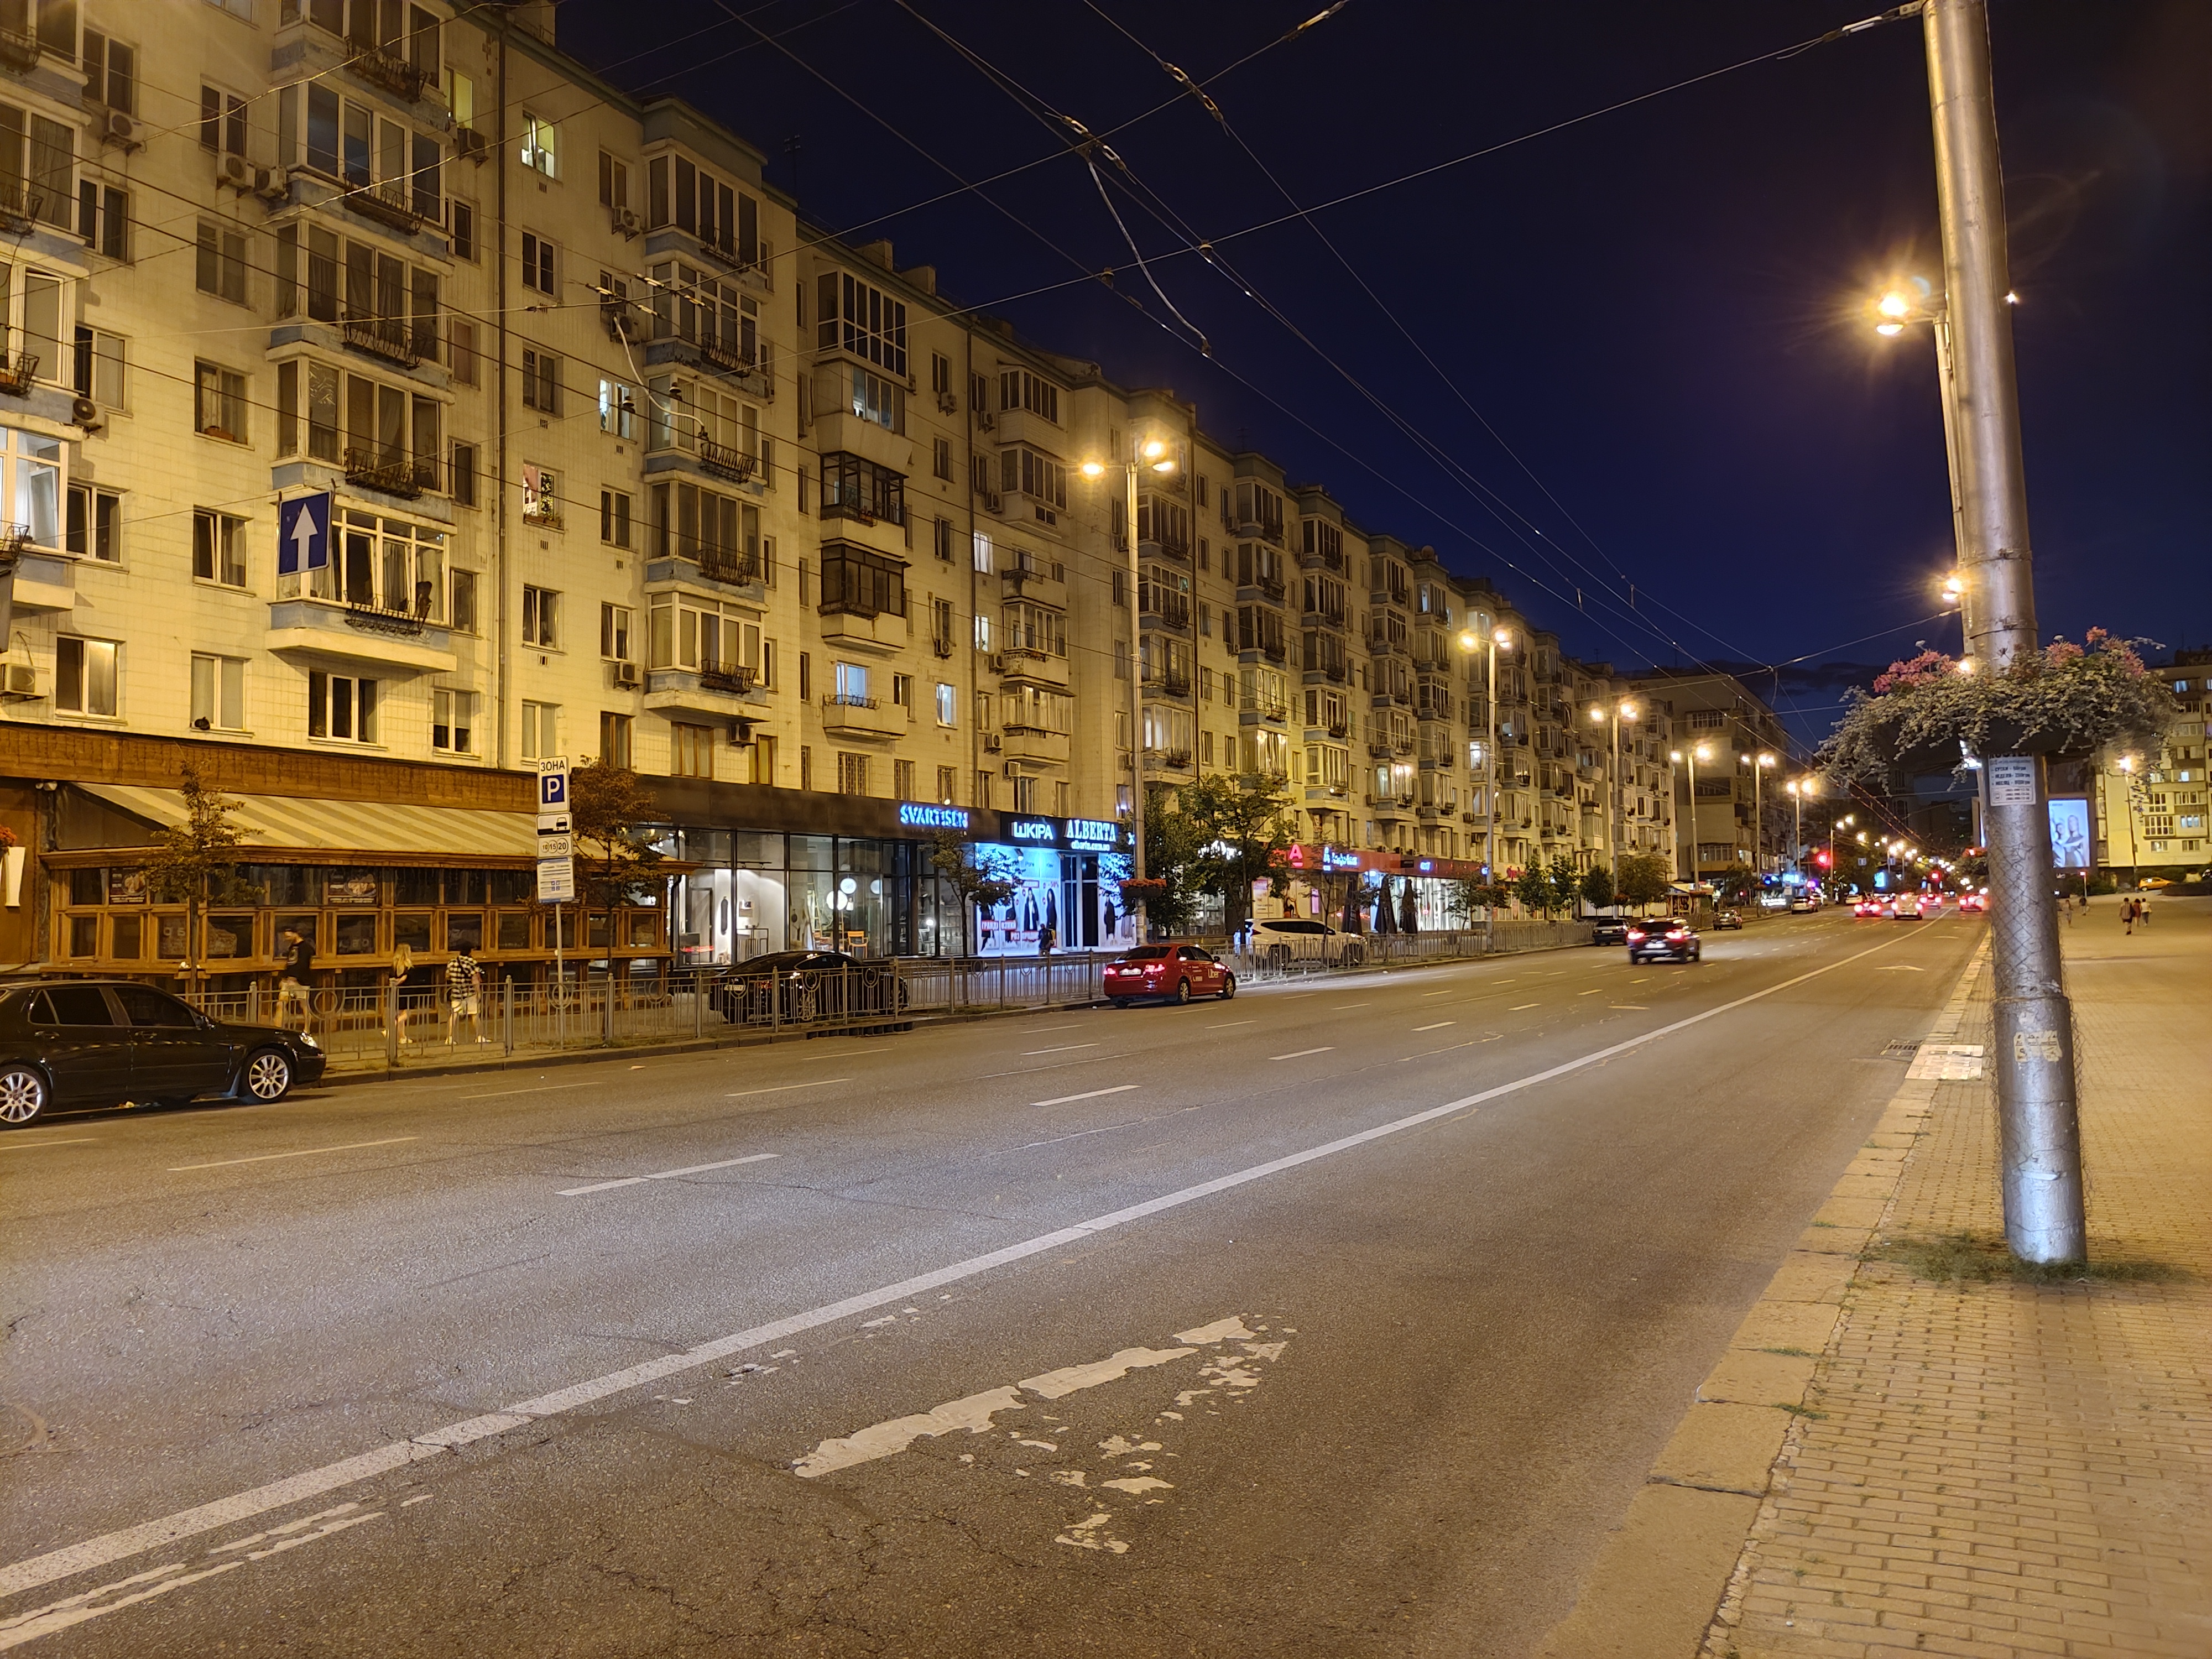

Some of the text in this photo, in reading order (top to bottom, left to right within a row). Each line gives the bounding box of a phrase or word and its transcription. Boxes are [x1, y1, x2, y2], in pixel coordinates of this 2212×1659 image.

[540, 760, 565, 772] ЗОНА
[547, 778, 560, 801] P
[1013, 821, 1053, 840] ШКІРА
[1066, 820, 1116, 842] ALBERTA
[558, 842, 566, 850] 20
[1208, 968, 1220, 979] Uber
